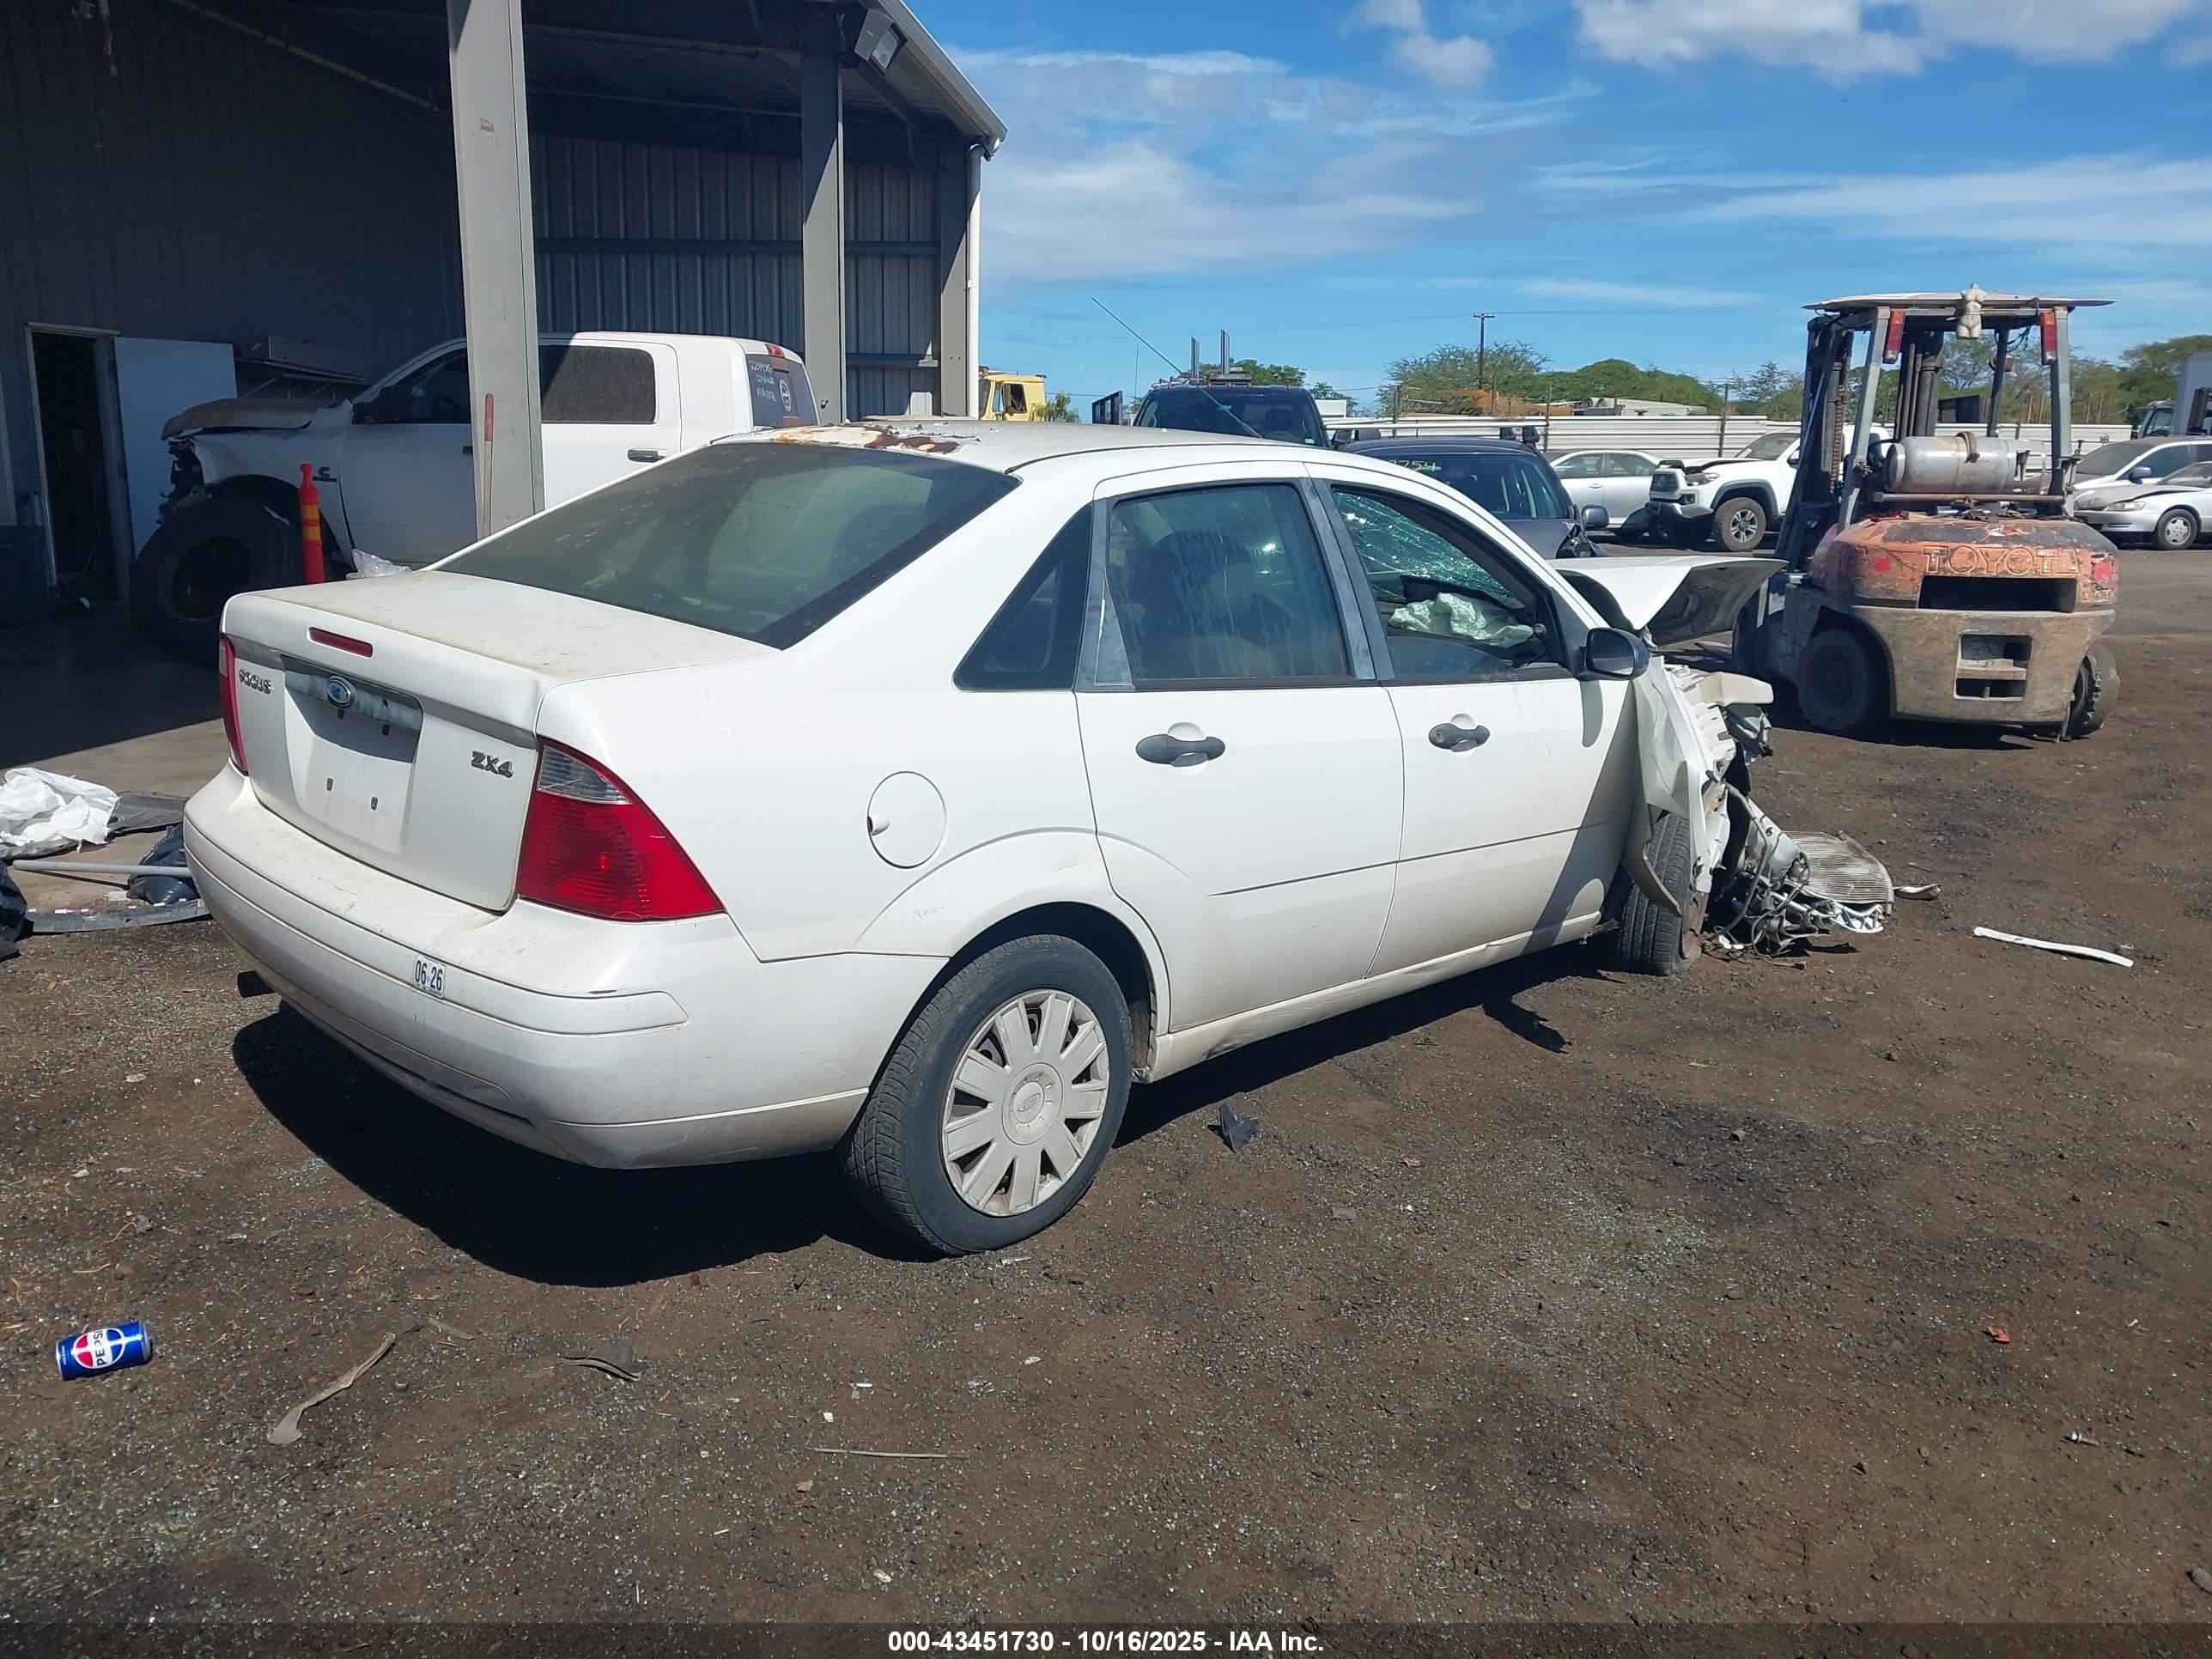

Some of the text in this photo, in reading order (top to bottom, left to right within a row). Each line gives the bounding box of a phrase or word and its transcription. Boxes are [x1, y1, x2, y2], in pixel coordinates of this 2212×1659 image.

[1923, 545, 2081, 575] TOYOTA
[471, 750, 514, 778] ZX4
[415, 960, 427, 985] 06
[430, 966, 442, 992] 26
